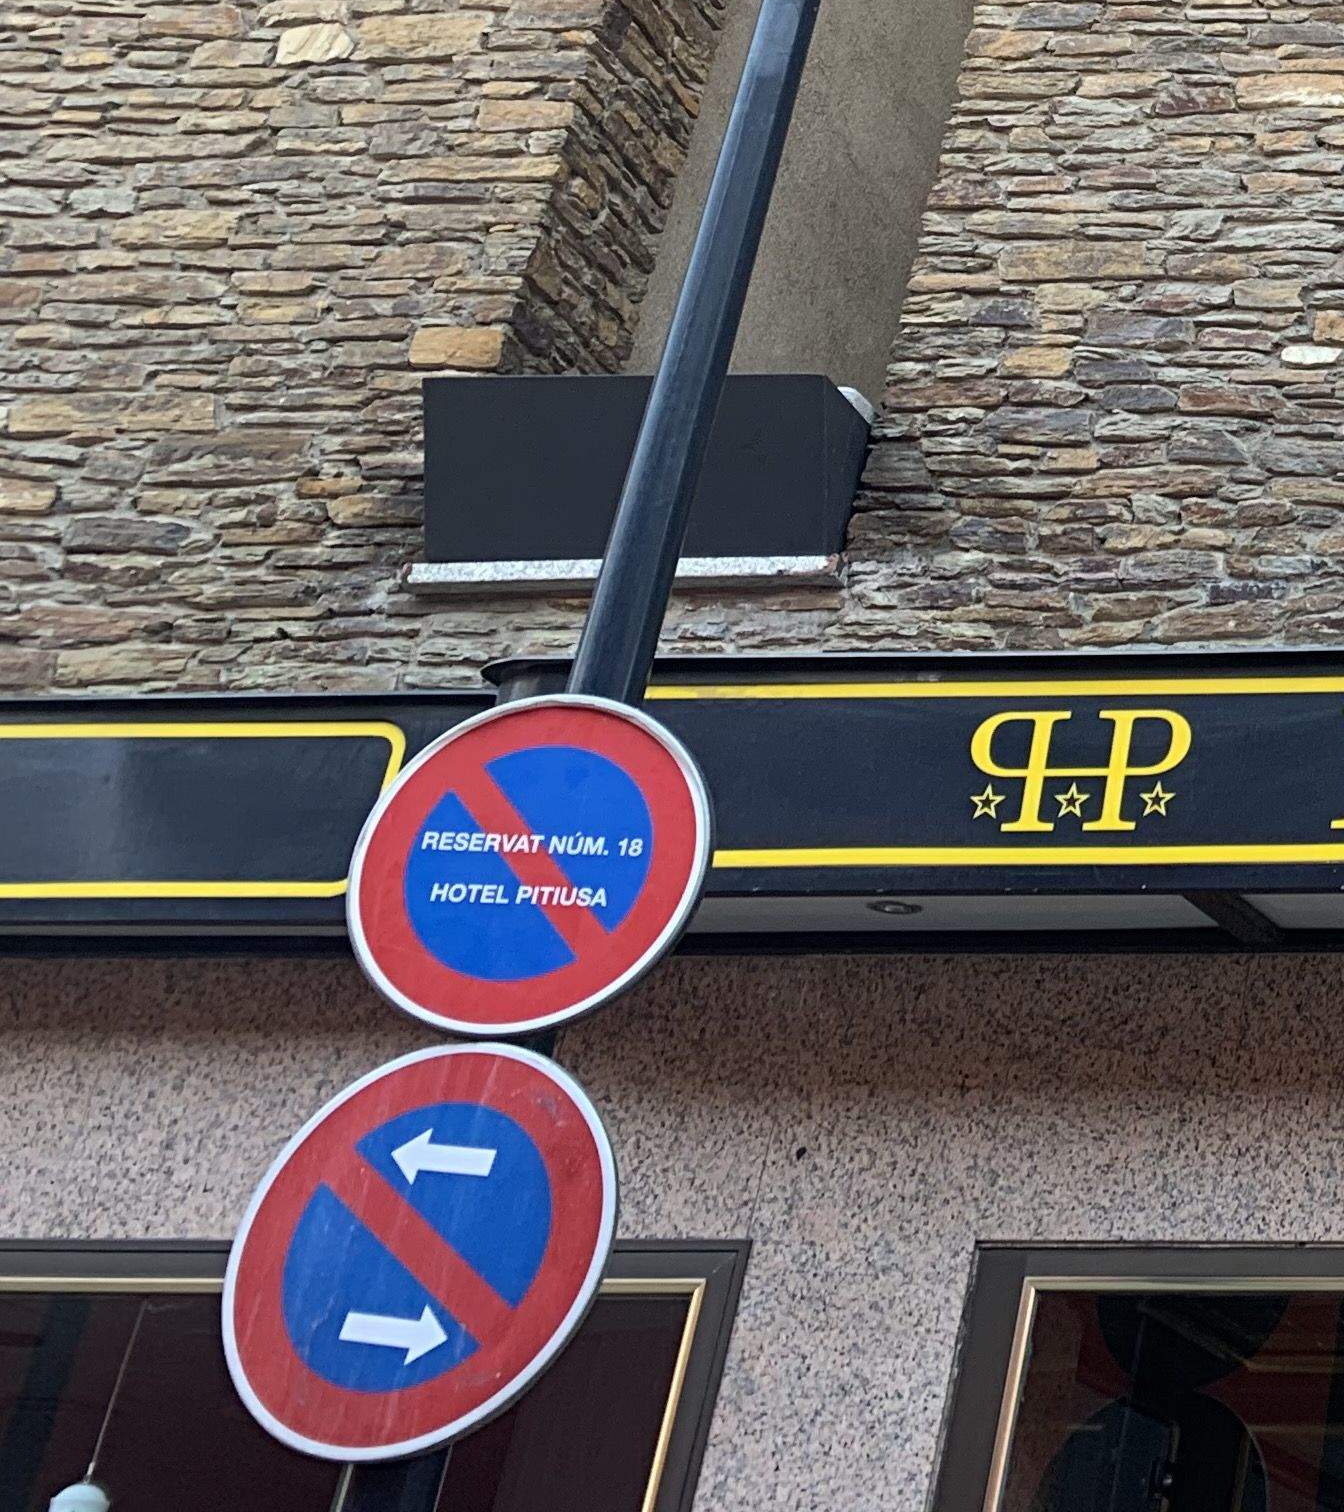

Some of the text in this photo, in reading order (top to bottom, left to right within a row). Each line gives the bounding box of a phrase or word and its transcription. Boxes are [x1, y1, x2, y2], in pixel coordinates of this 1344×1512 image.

[421, 831, 644, 857] RESERVAT NÚM. 18
[429, 883, 608, 907] HOTEL PITIUSA
